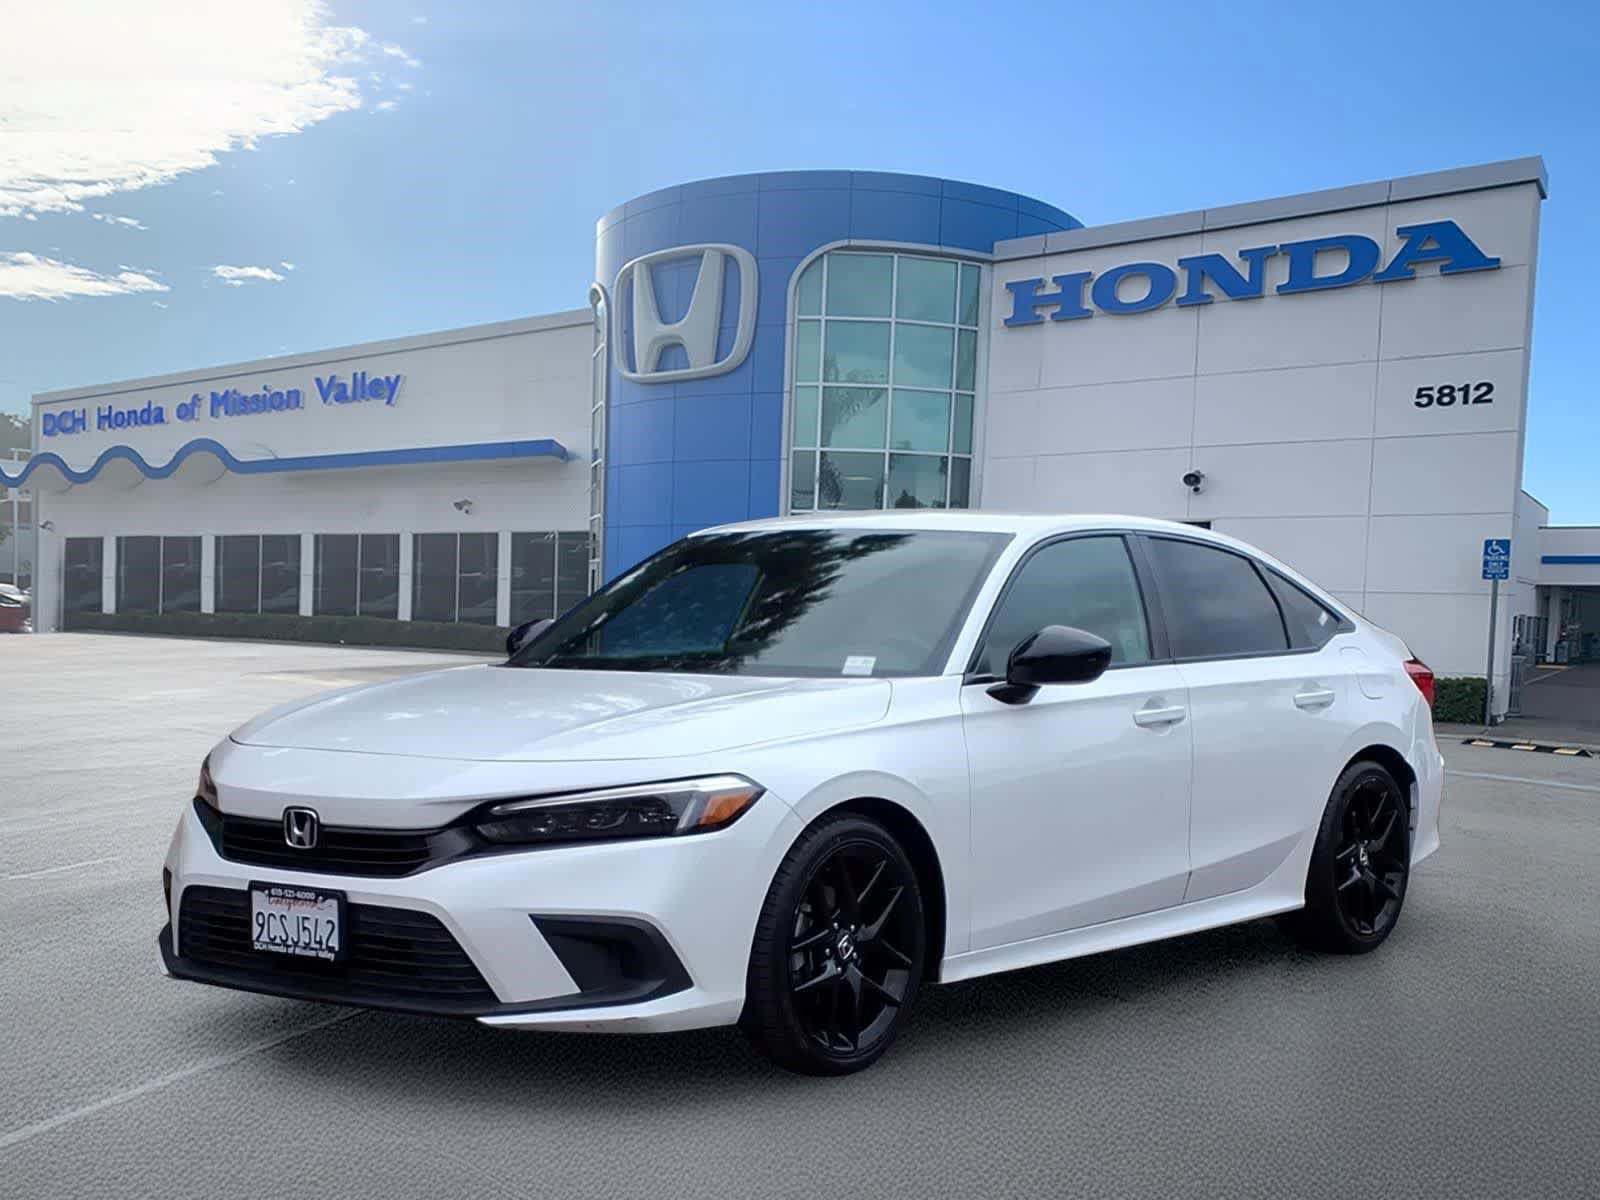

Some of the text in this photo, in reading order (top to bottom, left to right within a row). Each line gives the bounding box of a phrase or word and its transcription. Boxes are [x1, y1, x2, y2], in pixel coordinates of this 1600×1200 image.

[1003, 219, 1501, 328] HONDA
[42, 371, 402, 436] DCH Honda of Mission Valley
[1414, 382, 1494, 408] 5812
[255, 911, 336, 952] 9CSJ542
